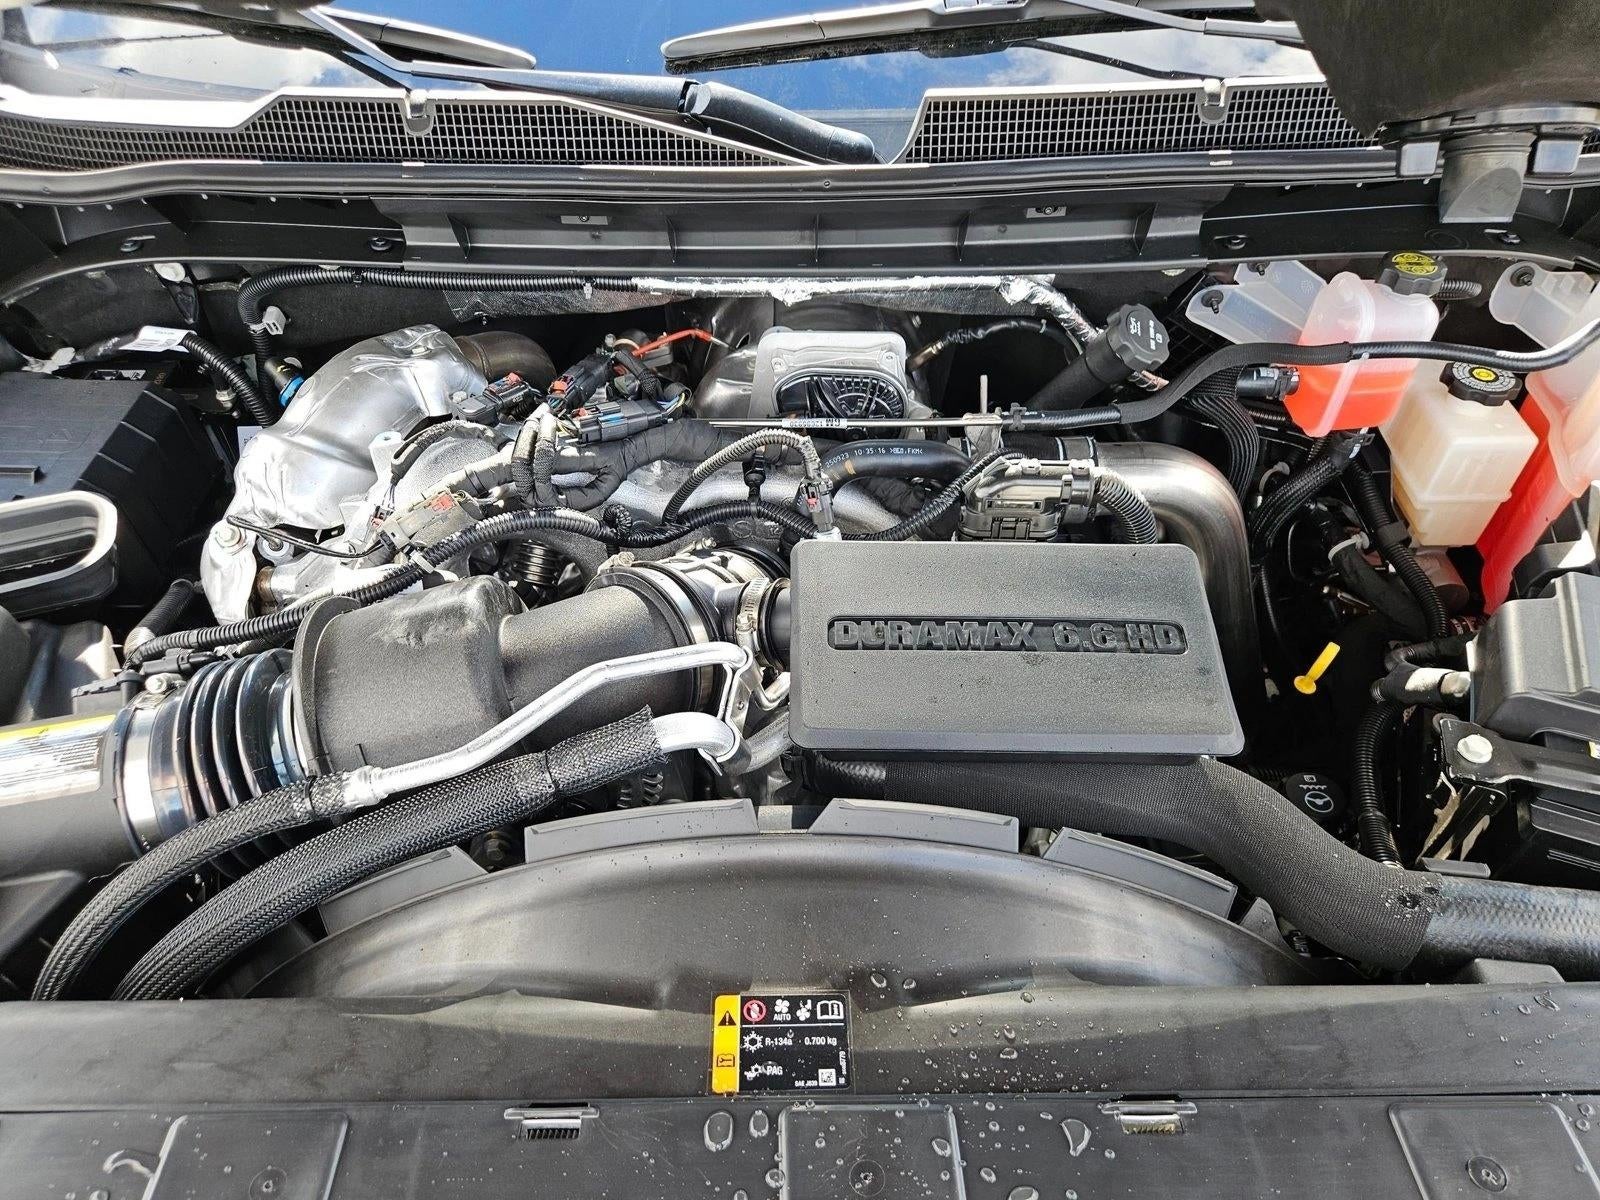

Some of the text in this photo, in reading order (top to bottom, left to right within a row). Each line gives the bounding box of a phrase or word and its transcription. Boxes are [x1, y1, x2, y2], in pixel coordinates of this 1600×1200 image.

[834, 621, 1184, 651] DURAMAX 6.6 HD
[773, 1013, 791, 1021] AUTO
[765, 1036, 837, 1046] R-134a 0.700 kg
[766, 1065, 783, 1076] PAG
